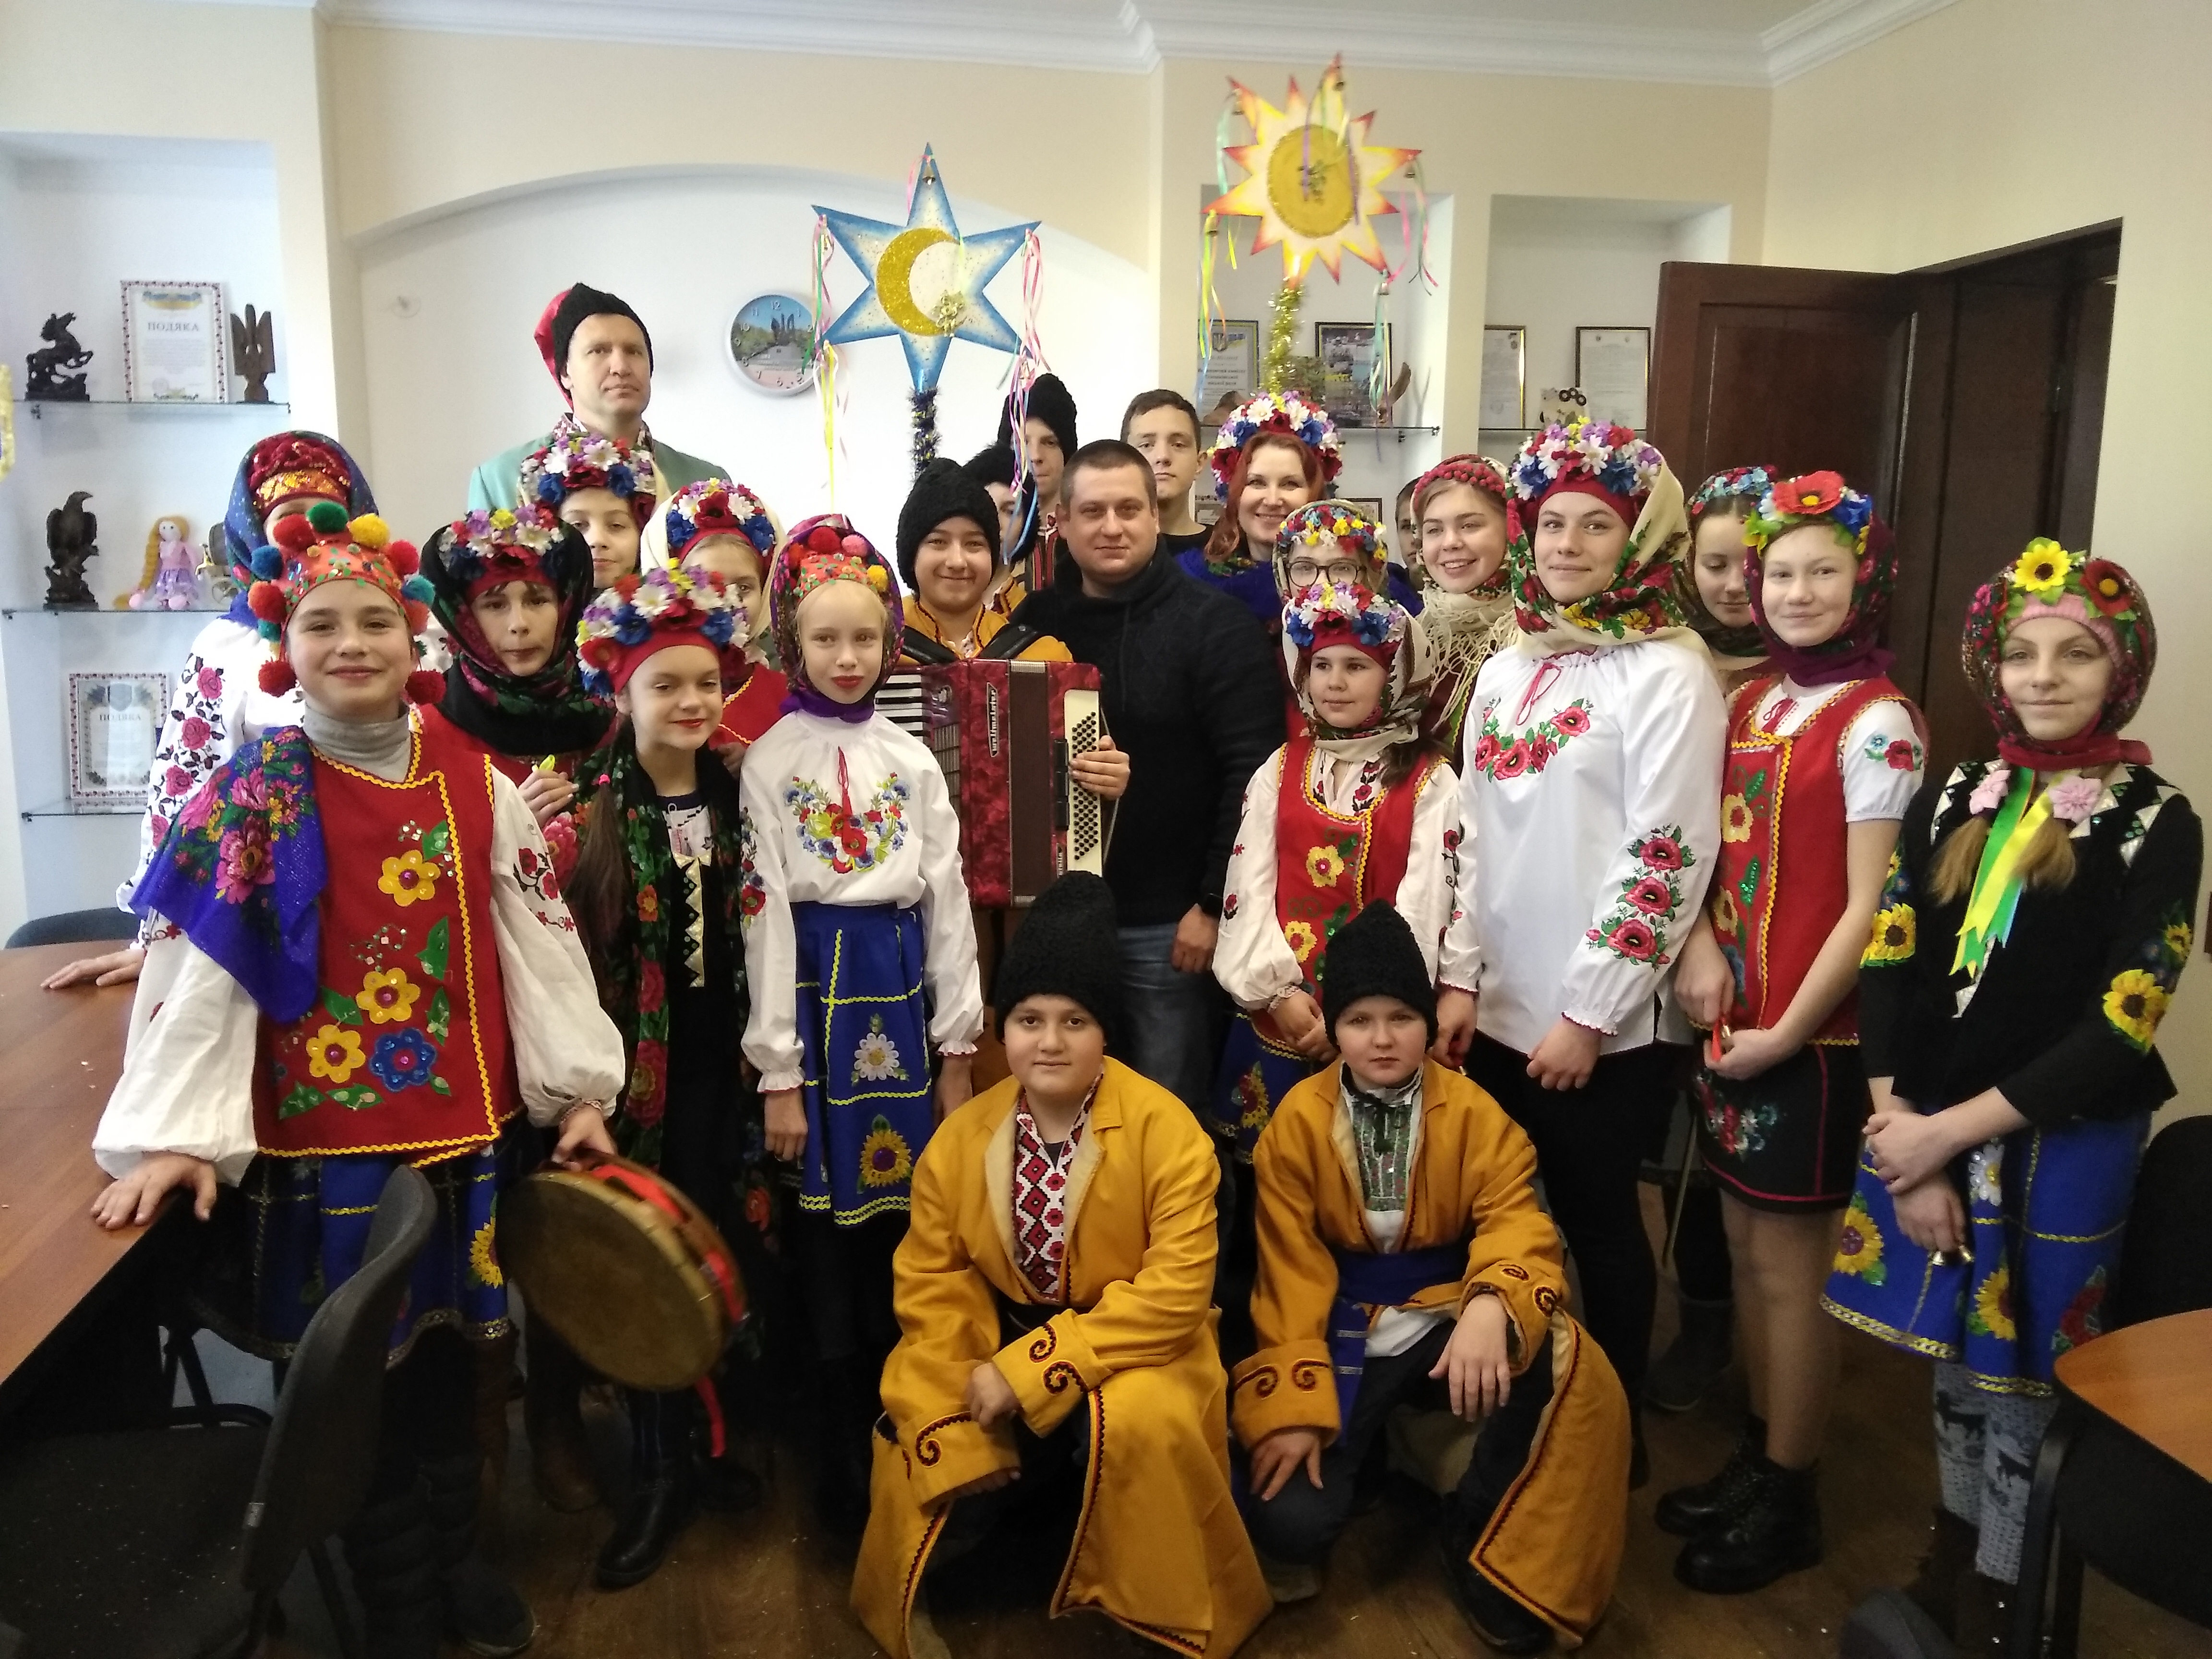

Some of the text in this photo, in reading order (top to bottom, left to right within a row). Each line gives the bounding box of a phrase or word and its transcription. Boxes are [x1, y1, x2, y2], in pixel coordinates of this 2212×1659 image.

[771, 301, 781, 310] 12
[751, 308, 759, 316] 11
[797, 309, 801, 317] 1
[148, 322, 199, 331] ПОДЯКА
[740, 323, 750, 331] 10
[807, 325, 813, 334] 2
[733, 337, 741, 347] 9
[741, 356, 749, 367] 8
[807, 359, 814, 369] 4
[756, 370, 762, 379] 7
[776, 377, 783, 387] 6
